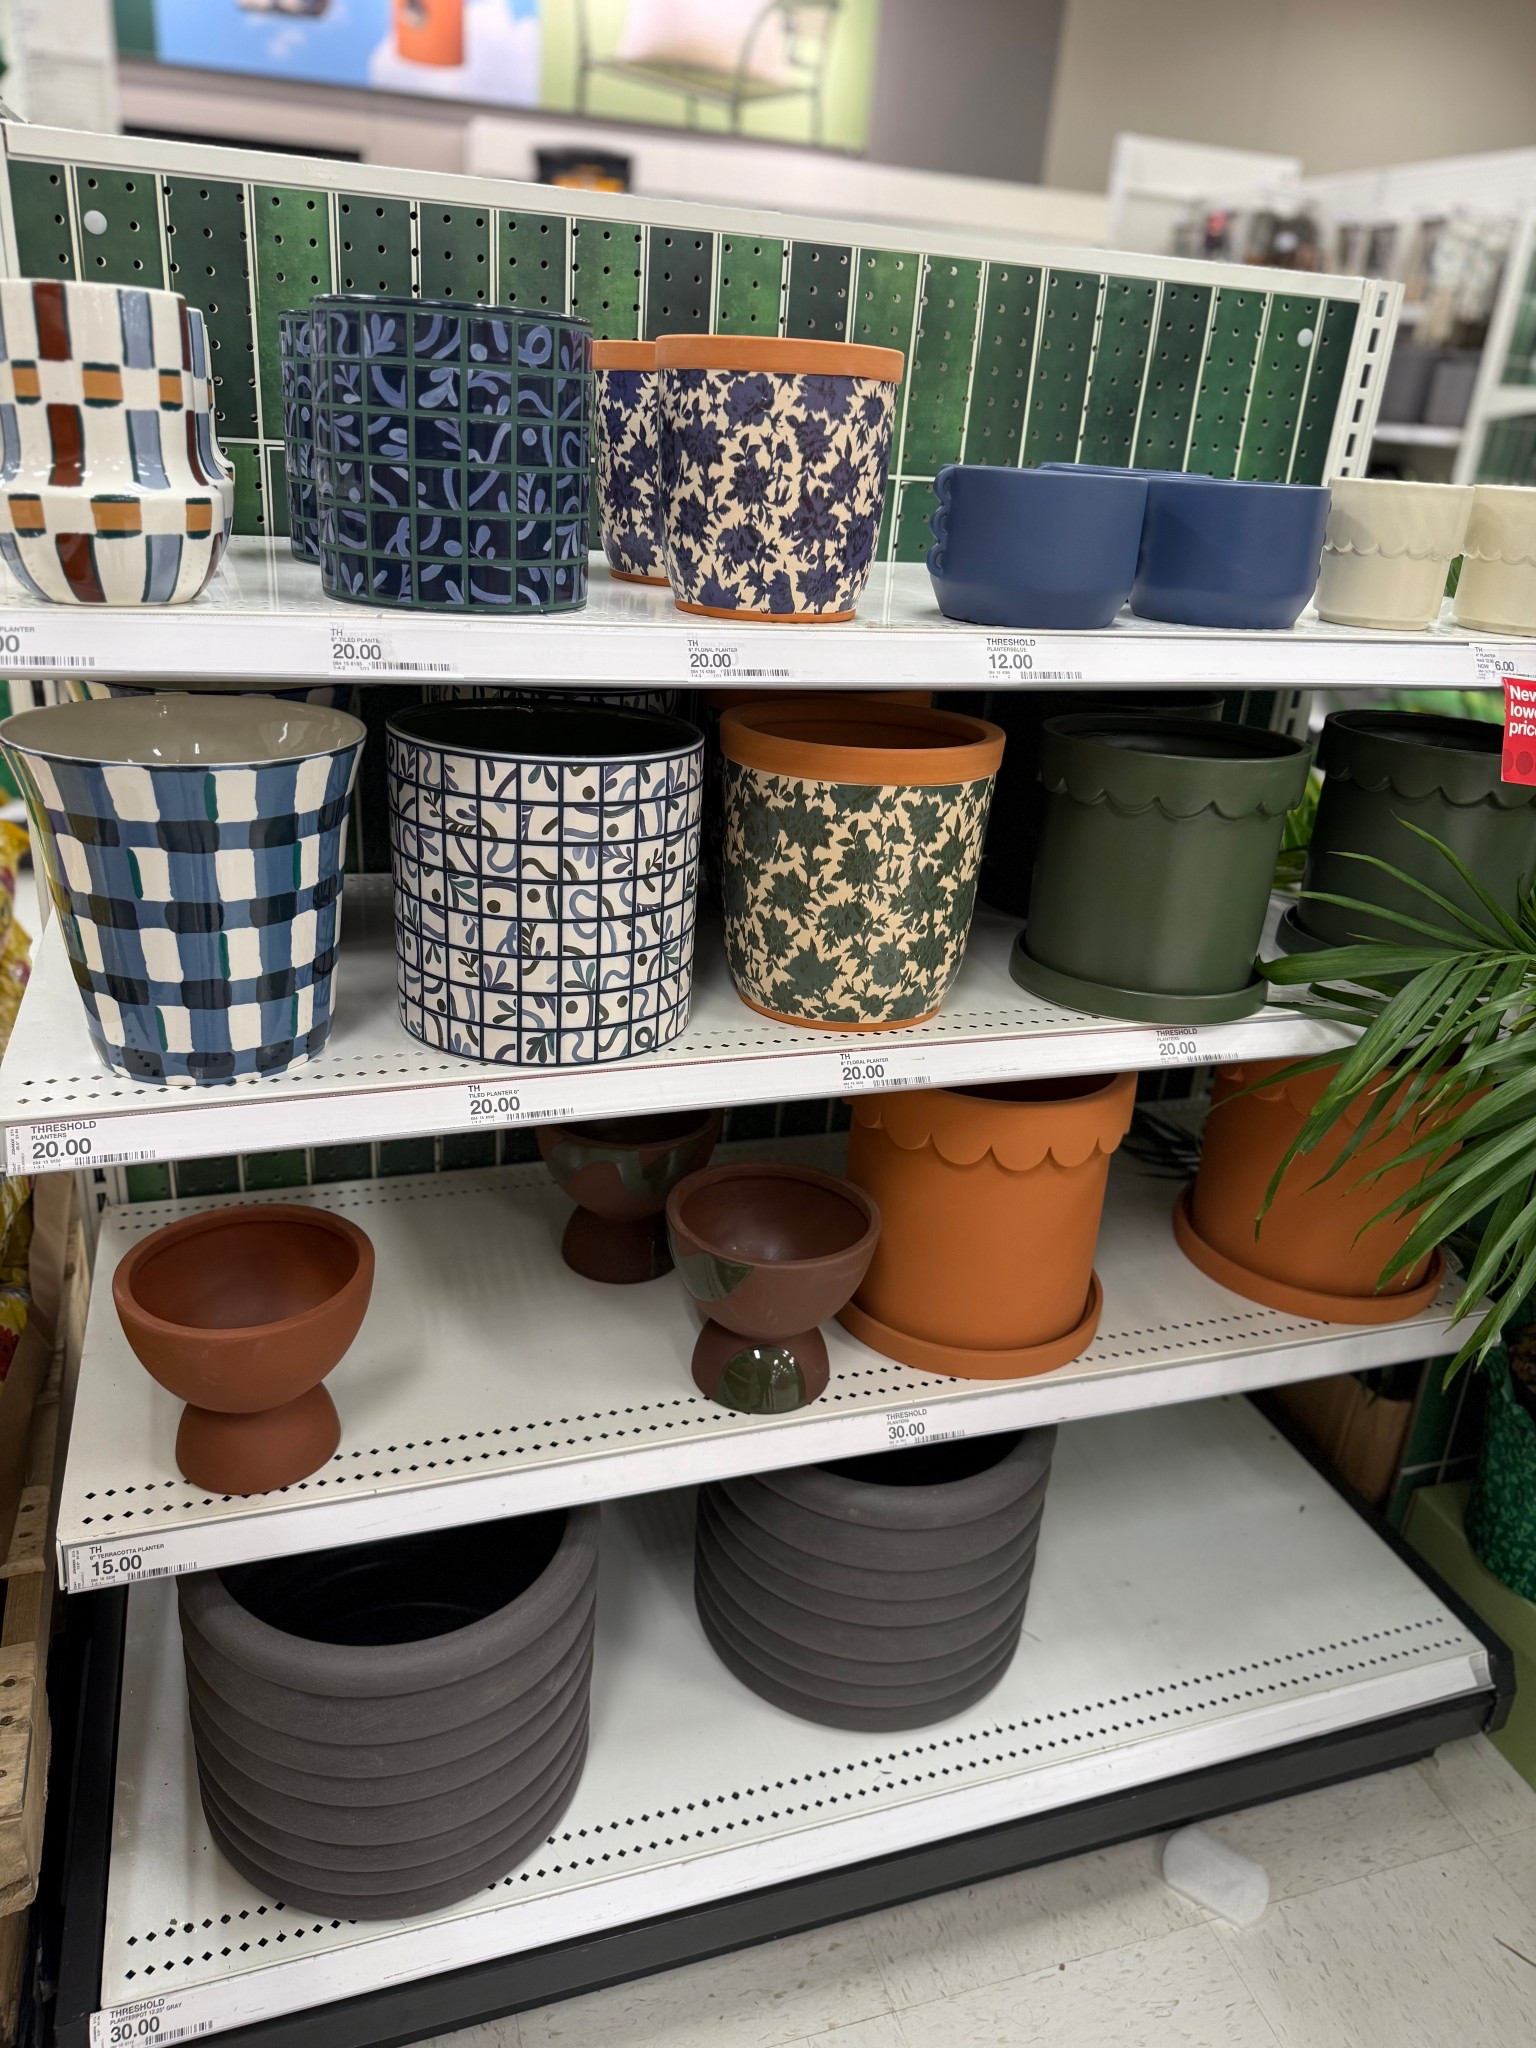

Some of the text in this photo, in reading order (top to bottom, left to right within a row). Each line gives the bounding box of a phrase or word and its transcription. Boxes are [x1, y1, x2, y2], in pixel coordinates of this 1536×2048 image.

[330, 628, 343, 636] TH
[986, 638, 1036, 647] THRESHOLD
[332, 644, 382, 660] 20.00
[690, 653, 731, 668] 20.00
[988, 653, 1033, 669] 12.00
[1494, 660, 1515, 672] 6.00
[1508, 719, 1536, 737] pric
[1156, 1028, 1198, 1037] THRESHOLD
[1158, 1041, 1197, 1056] 20.00
[842, 1064, 885, 1081] 20.00
[468, 1085, 481, 1093] TH
[470, 1096, 520, 1115] 20.00
[30, 1120, 97, 1134] THRESHOLD
[31, 1132, 67, 1141] PLANTERS
[32, 1138, 92, 1160] 20.00
[886, 1408, 928, 1421] THRESHOLD
[888, 1422, 925, 1440] 30.00
[89, 1546, 102, 1555] TH
[97, 1548, 137, 1559] TERRACOTTA
[137, 1543, 165, 1553] PLANTER
[91, 1554, 142, 1576] 15.00
[109, 2011, 148, 2026] PLANTERPOT
[166, 2002, 183, 2011] GRAY
[110, 1998, 165, 2019] THRESHOLD
[110, 2016, 160, 2043] 30.00
